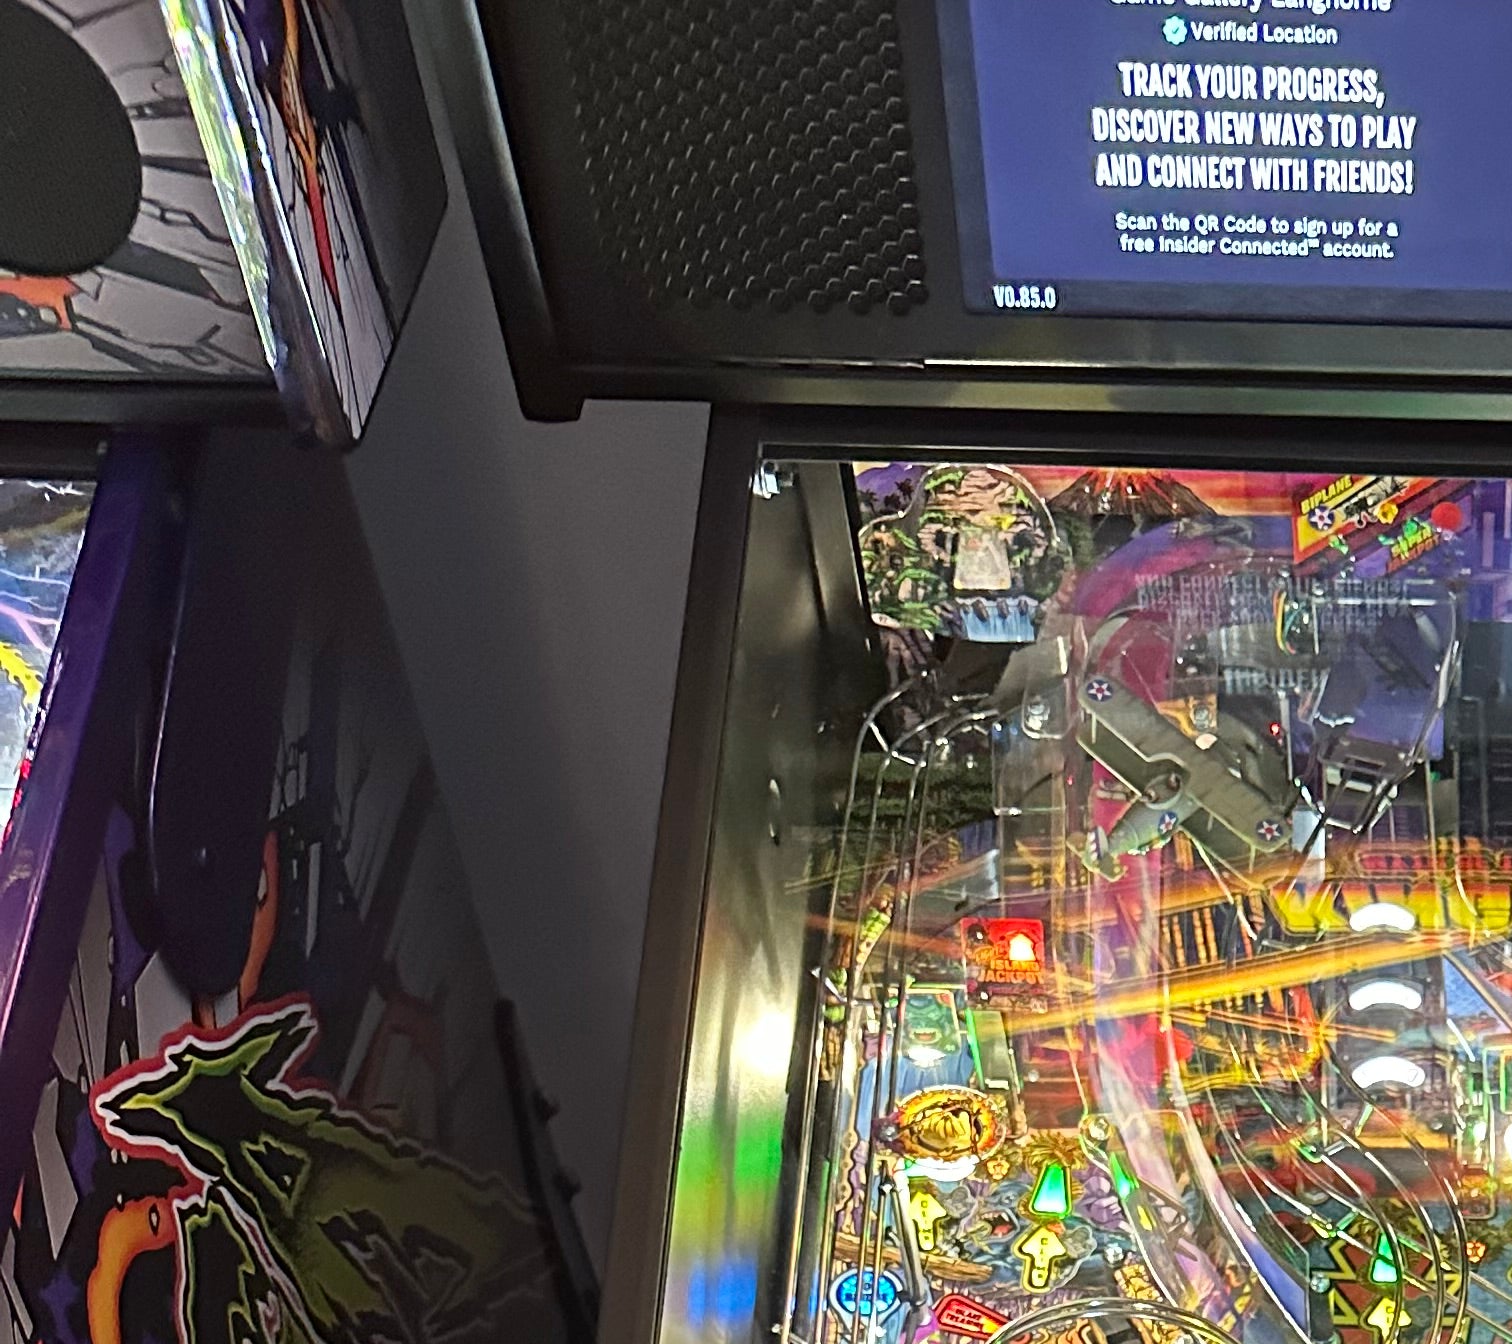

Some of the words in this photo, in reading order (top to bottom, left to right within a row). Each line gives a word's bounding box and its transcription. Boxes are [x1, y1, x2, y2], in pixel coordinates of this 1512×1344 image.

[1191, 21, 1257, 42] Verified
[1263, 24, 1338, 44] Location
[1118, 62, 1192, 98] TRACK
[1194, 64, 1257, 99] YOUR
[1262, 66, 1386, 109] PROGRESS,
[1092, 108, 1200, 144] DISCOVER
[1204, 111, 1254, 145] NEW
[1259, 112, 1323, 147] WAYS
[1327, 114, 1357, 148] TO
[1362, 116, 1416, 149] PLAY
[1096, 154, 1143, 187] AND
[1147, 155, 1246, 190] CONNECT
[1249, 157, 1308, 191] WITH
[1313, 159, 1414, 194] FRIENDS!
[1115, 212, 1157, 230] Scan
[1161, 213, 1190, 231] the
[1195, 214, 1219, 235] QR
[1224, 215, 1267, 233] Code
[1271, 217, 1289, 233] to
[1294, 217, 1327, 238] sign
[1331, 221, 1353, 239] up
[1358, 217, 1383, 236] for
[1386, 222, 1398, 237] a
[1120, 233, 1154, 252] free
[1159, 235, 1216, 253] Insider
[1323, 242, 1394, 258] account.
[993, 285, 1057, 310] V0.85.0
[1301, 475, 1353, 514] BIPLANE
[977, 969, 1045, 984] JACKPOT
[990, 960, 1040, 971] ISLAND
